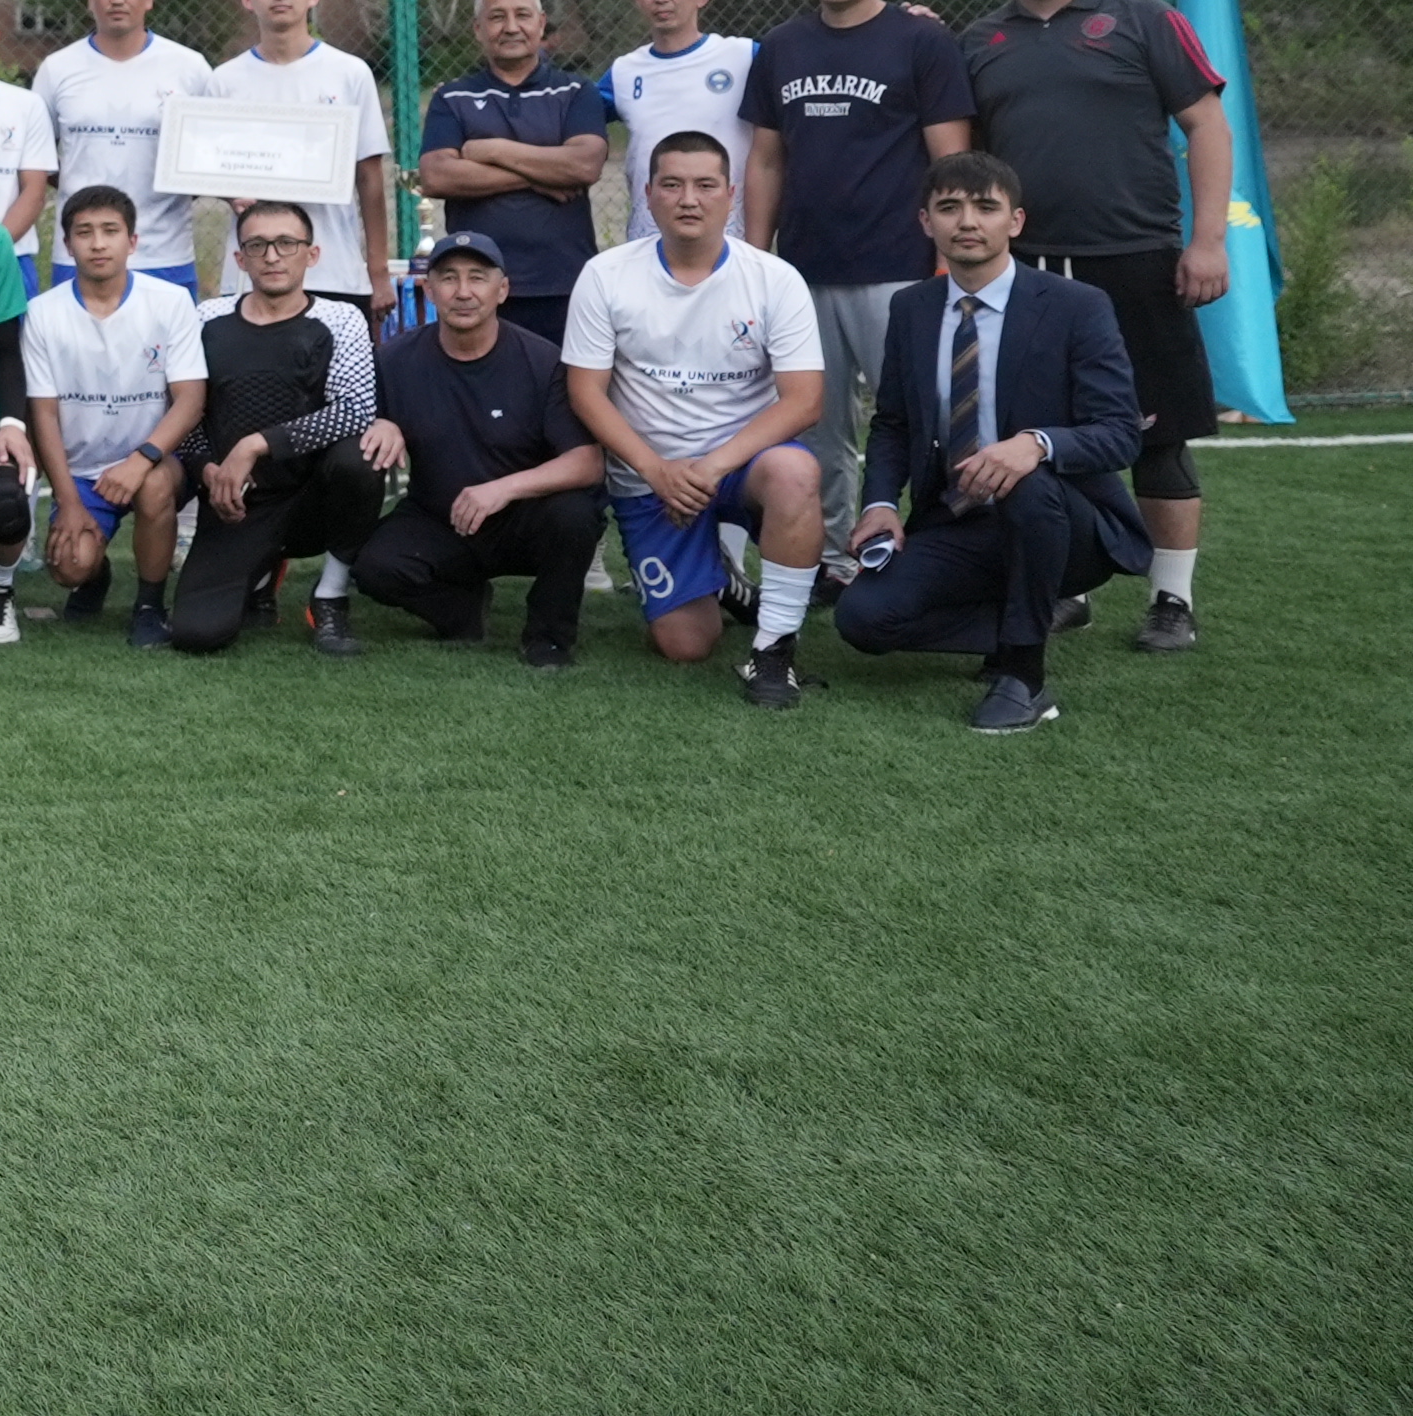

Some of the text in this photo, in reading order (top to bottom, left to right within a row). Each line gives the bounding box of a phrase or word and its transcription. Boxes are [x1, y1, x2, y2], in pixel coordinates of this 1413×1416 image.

[632, 75, 643, 100] 8
[781, 74, 888, 105] SHAKARIM
[119, 126, 161, 136] UNIVER
[639, 366, 762, 382] KARIM UNIVERSITY
[57, 392, 107, 402] HAKARIM
